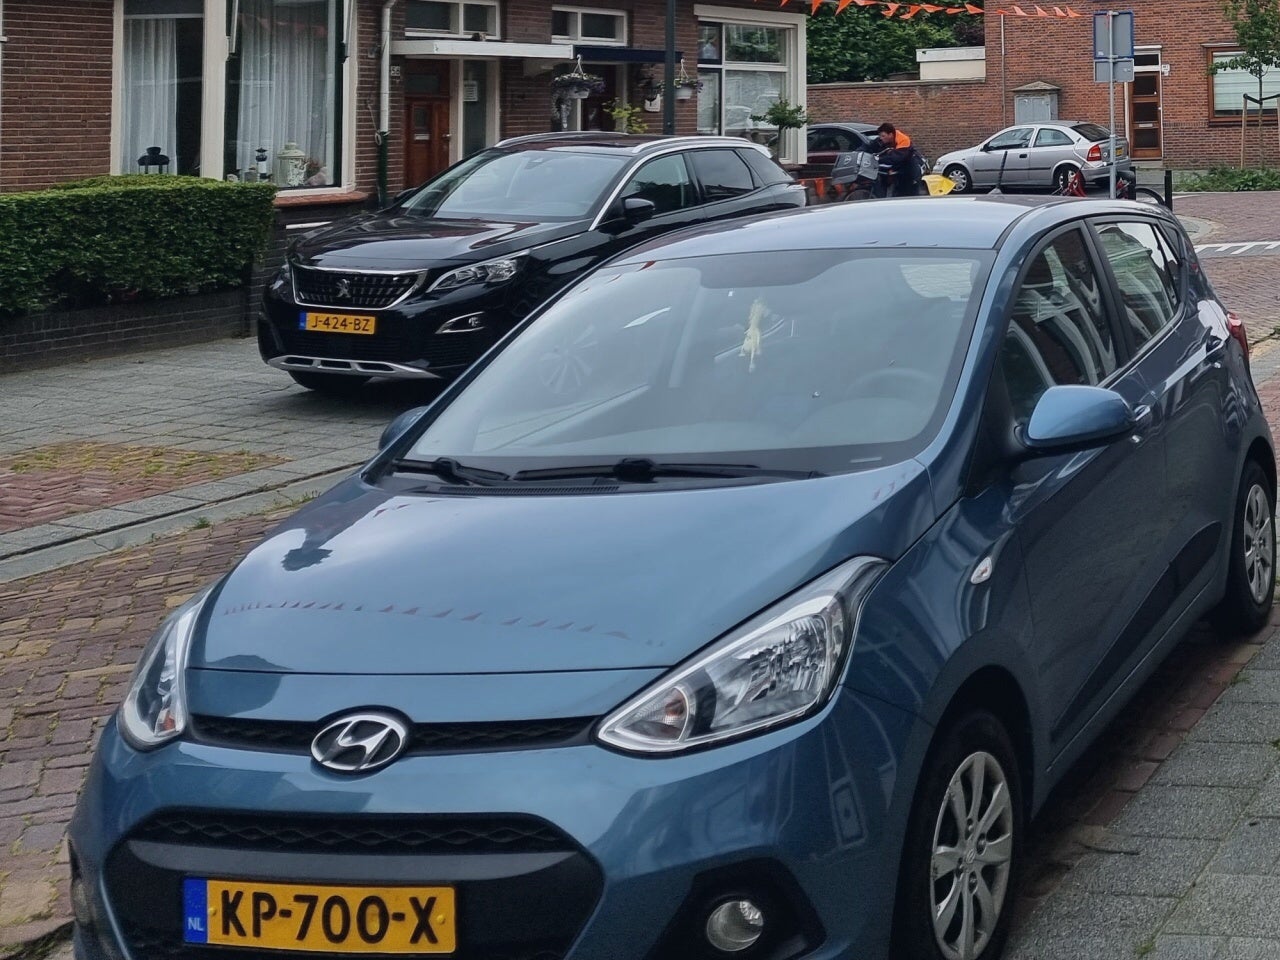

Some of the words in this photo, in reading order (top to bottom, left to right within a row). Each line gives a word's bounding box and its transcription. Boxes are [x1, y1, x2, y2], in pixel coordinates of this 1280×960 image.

[311, 315, 370, 332] J-424-BZ
[187, 917, 204, 932] NL
[221, 890, 439, 945] KP-700-X
